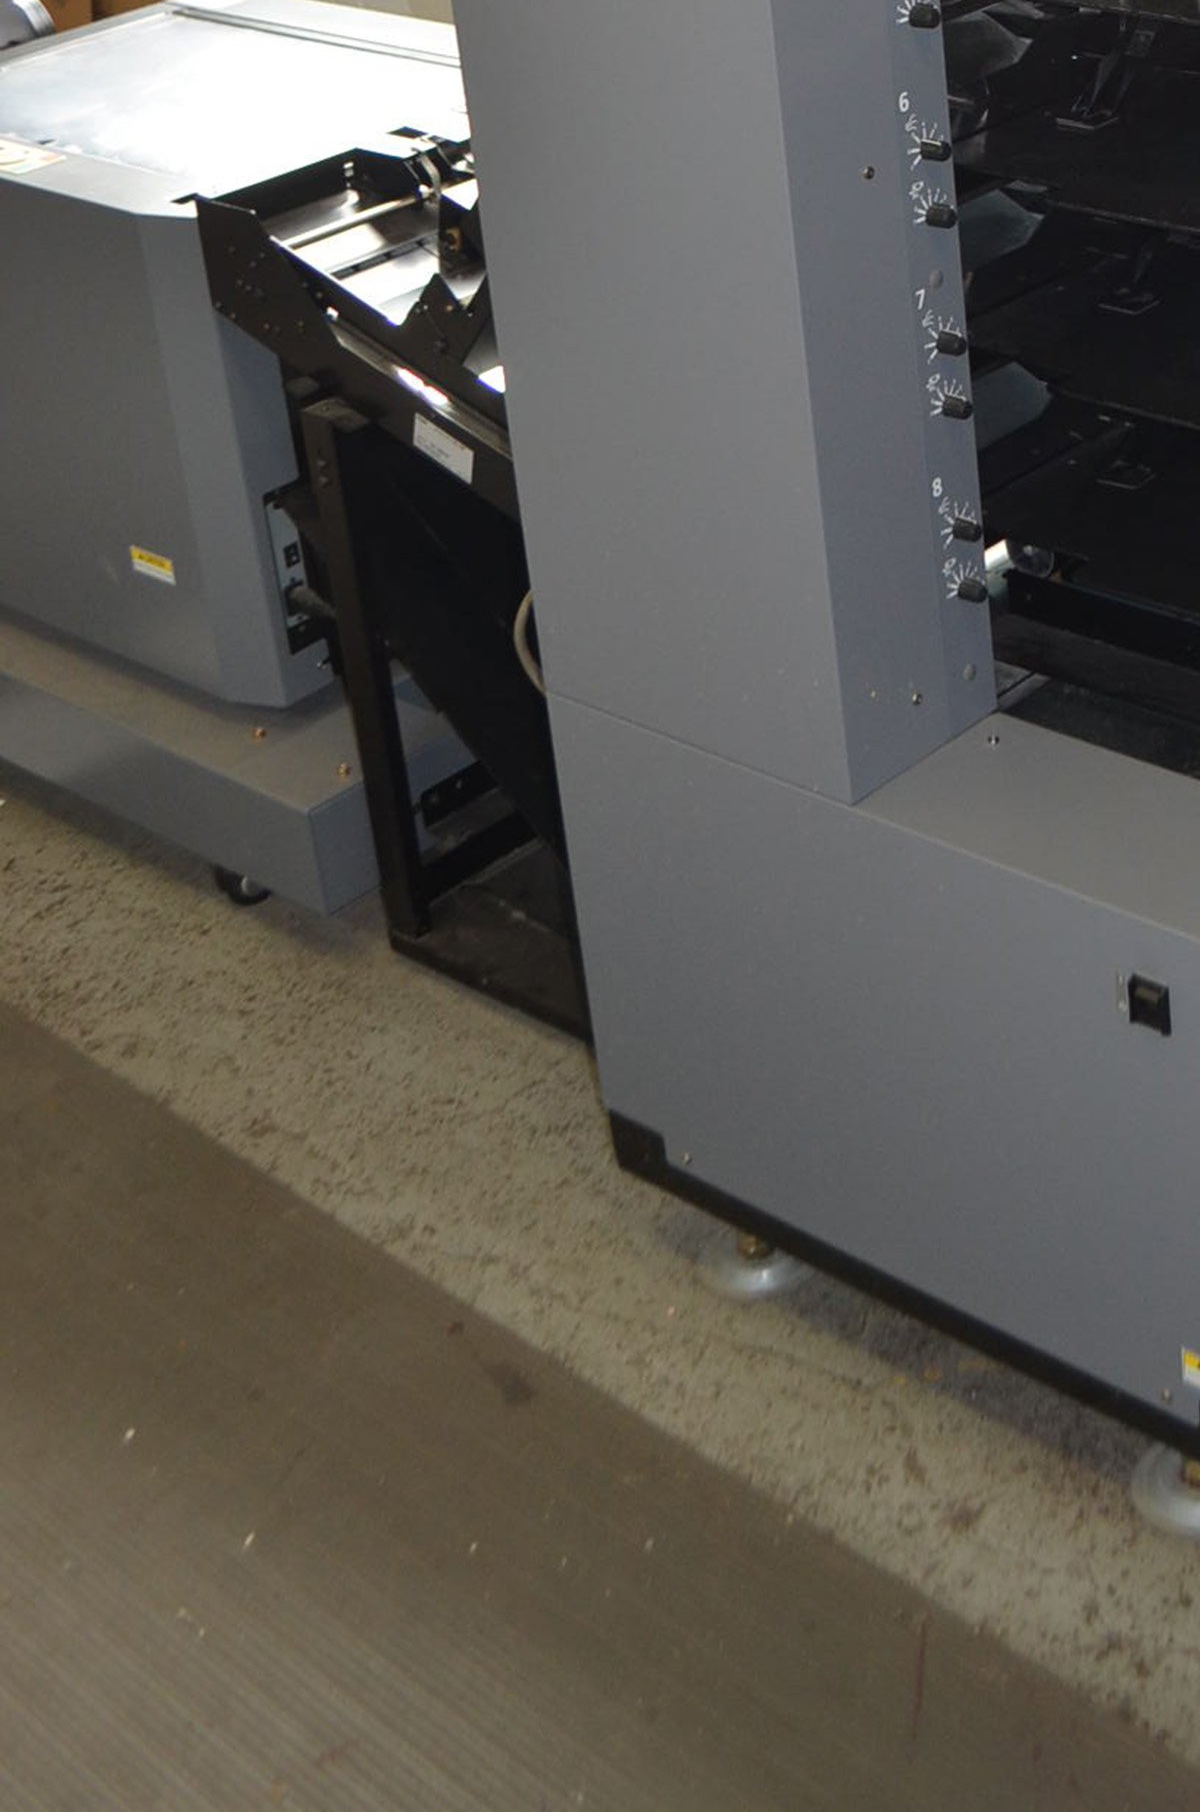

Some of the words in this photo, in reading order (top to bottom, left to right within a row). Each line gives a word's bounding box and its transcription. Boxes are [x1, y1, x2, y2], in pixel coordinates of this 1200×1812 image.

[898, 91, 910, 113] 6
[914, 288, 926, 310] 7
[931, 477, 943, 498] 8
